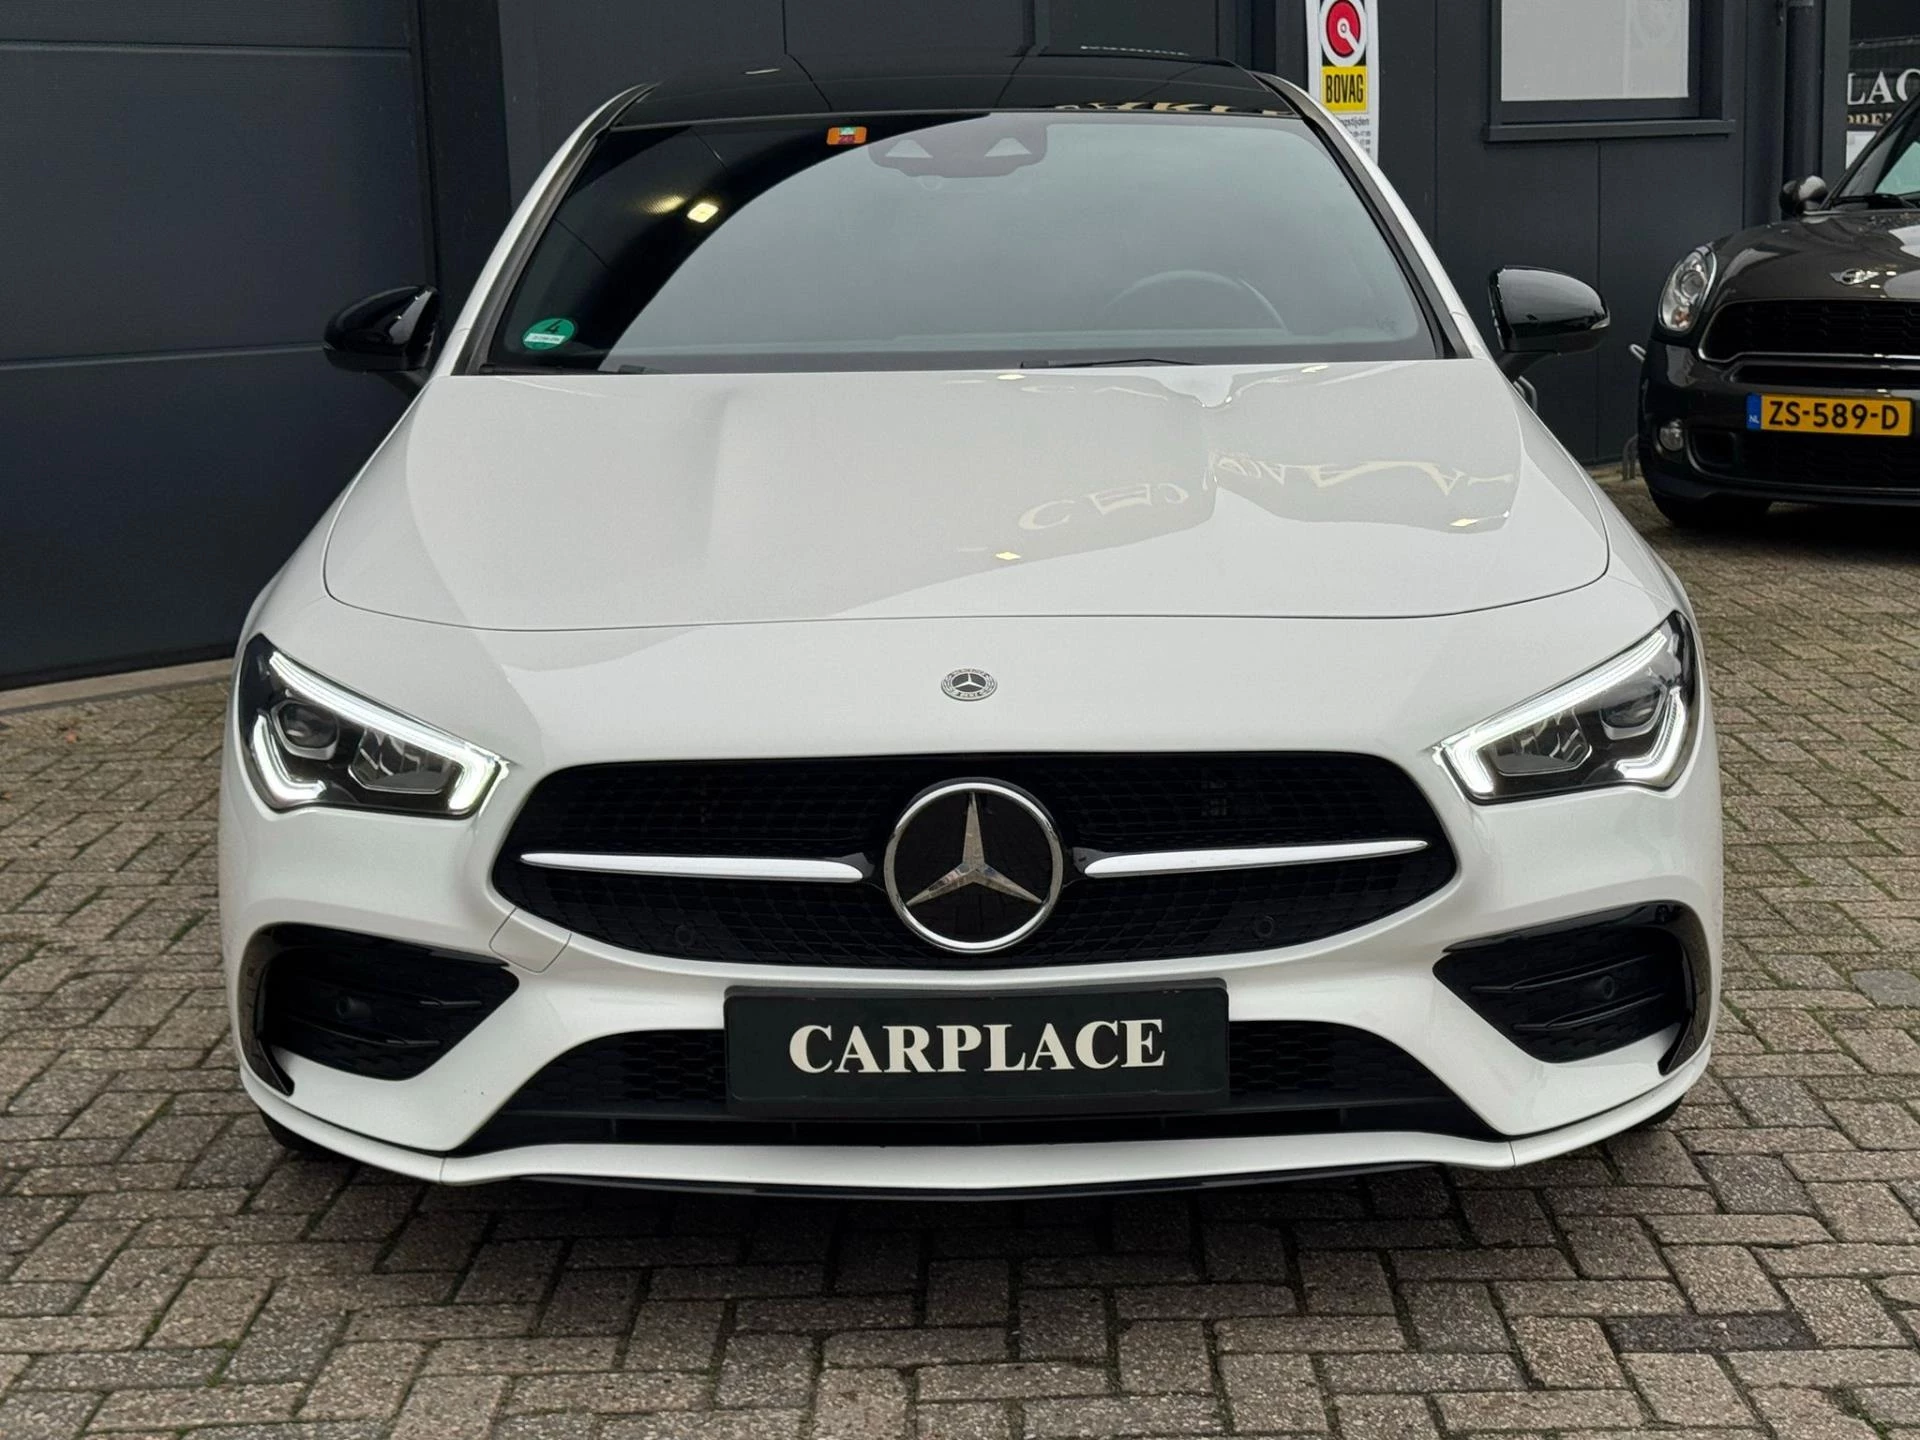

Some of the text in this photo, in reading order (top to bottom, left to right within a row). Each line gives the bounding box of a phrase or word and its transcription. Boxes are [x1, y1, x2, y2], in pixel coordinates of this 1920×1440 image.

[1325, 74, 1364, 104] BOVAG
[1768, 400, 1899, 430] ZS-589-D
[788, 1018, 1166, 1074] CARPLACE
